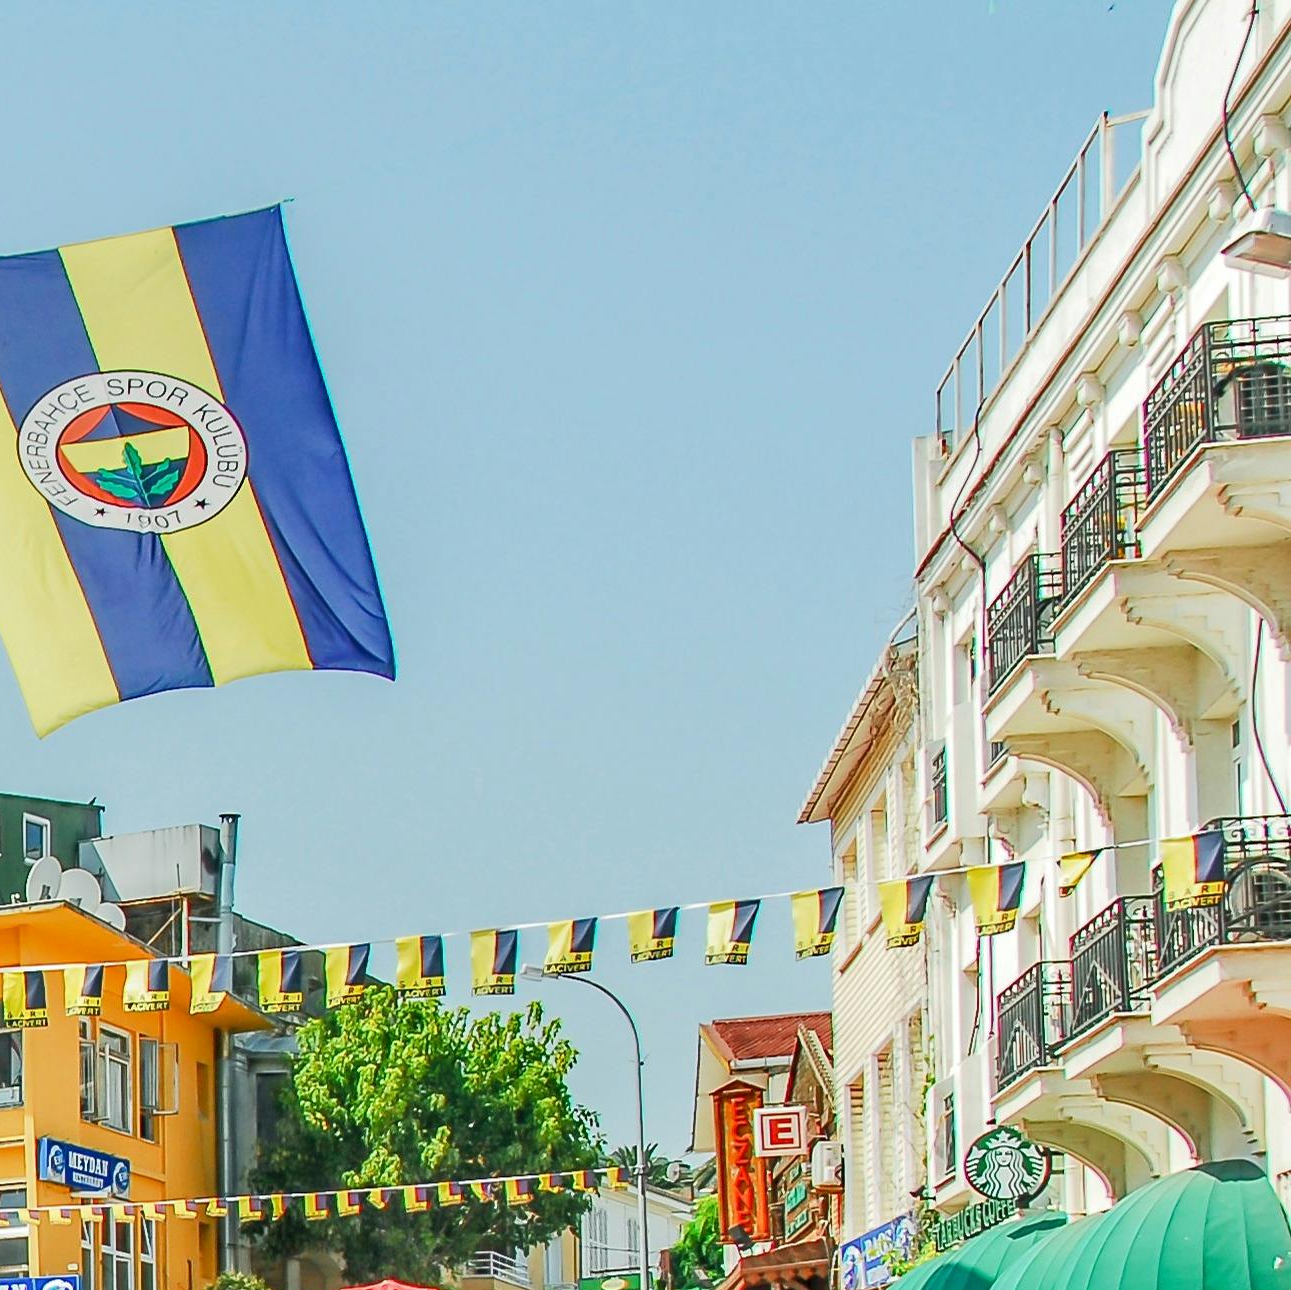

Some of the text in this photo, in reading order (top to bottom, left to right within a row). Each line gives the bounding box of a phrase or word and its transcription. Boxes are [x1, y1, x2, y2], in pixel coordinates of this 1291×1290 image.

[26, 378, 243, 507] FENERBAHÇE SPOR KULÜBÜ
[124, 510, 182, 529] 1907
[769, 1118, 794, 1145] E
[68, 1151, 109, 1177] MEYDAN
